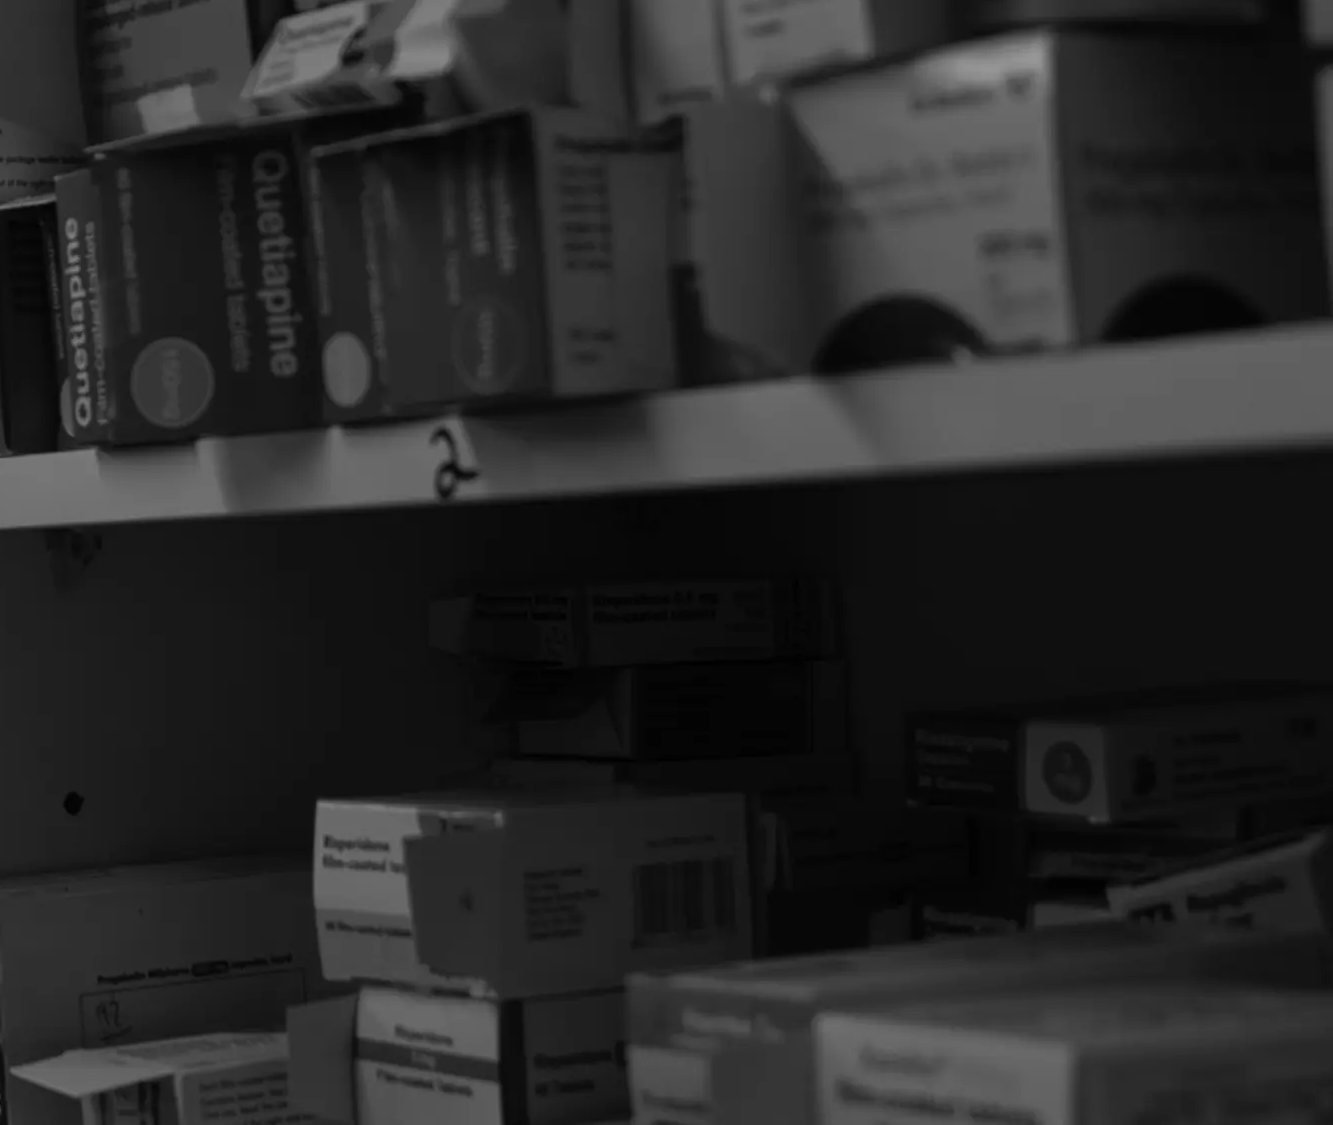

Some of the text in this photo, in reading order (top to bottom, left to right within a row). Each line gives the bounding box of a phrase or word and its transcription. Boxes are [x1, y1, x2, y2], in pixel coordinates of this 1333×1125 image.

[6, 155, 35, 165] package
[16, 178, 28, 187] the
[251, 150, 304, 377] Quetiapine
[64, 217, 93, 428] Quetiapine
[227, 293, 252, 372] tablets
